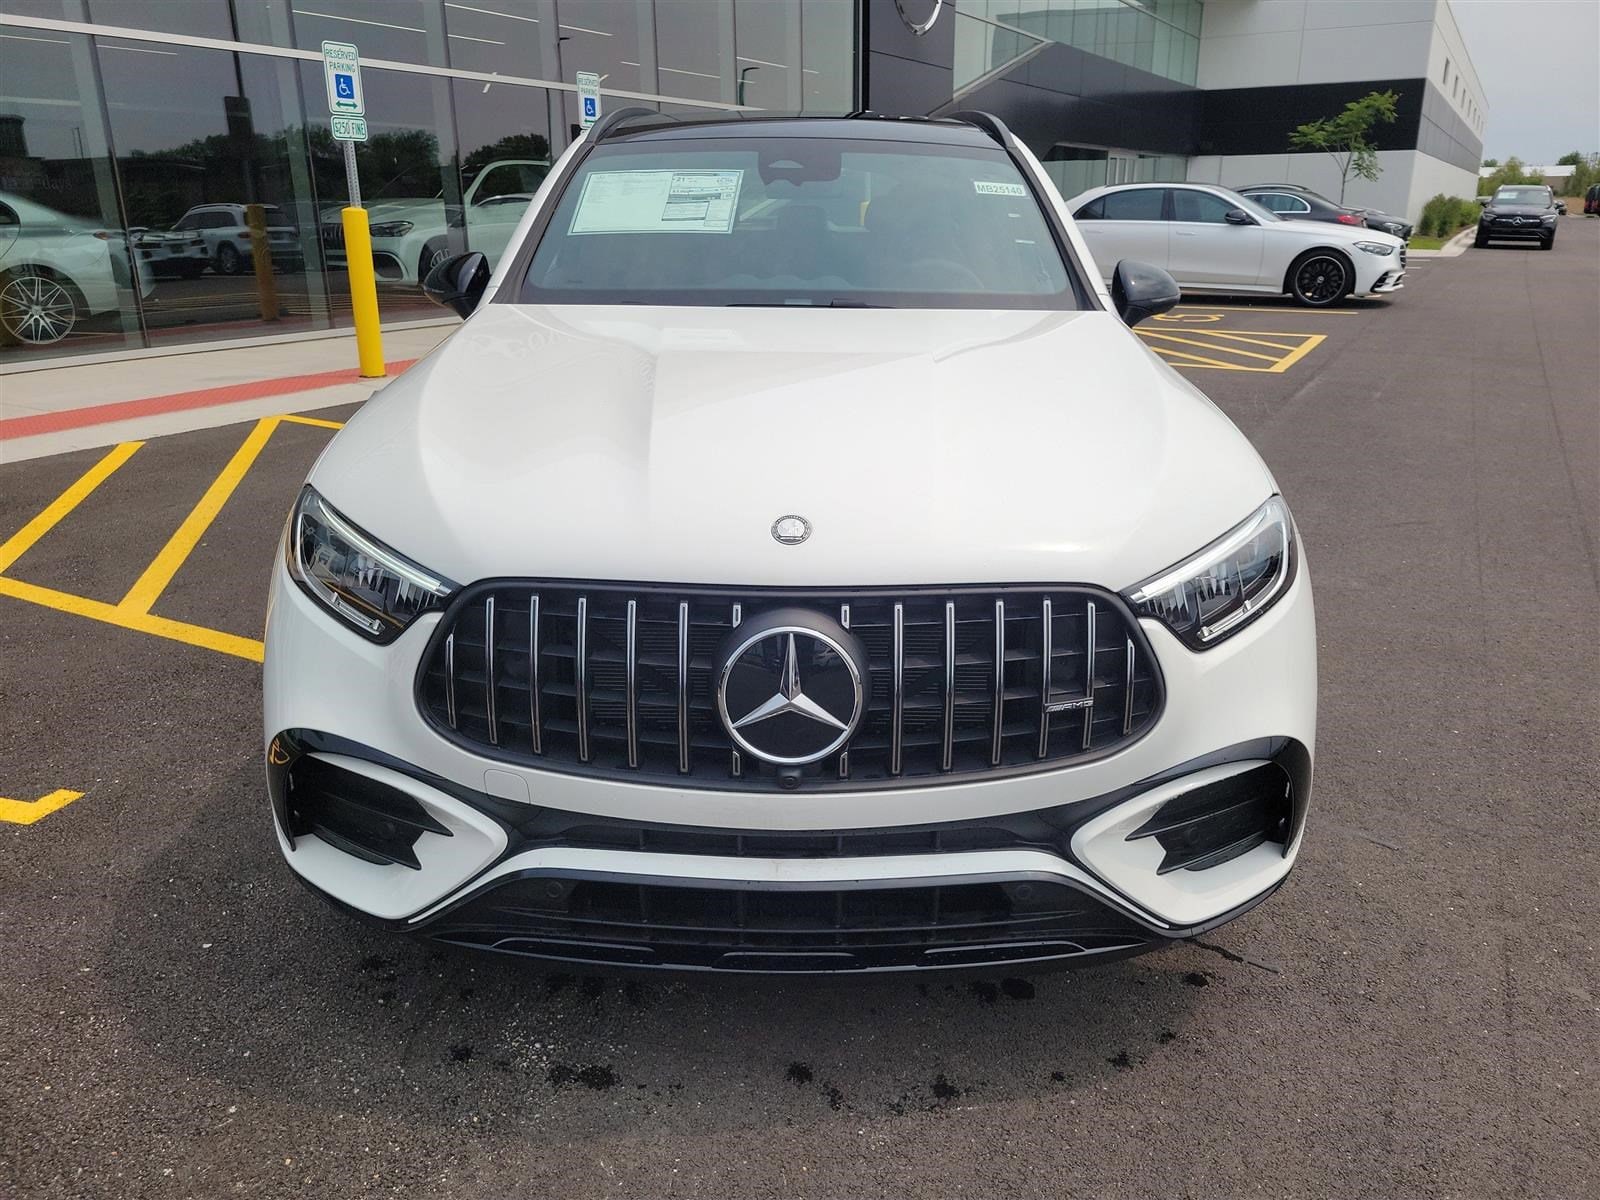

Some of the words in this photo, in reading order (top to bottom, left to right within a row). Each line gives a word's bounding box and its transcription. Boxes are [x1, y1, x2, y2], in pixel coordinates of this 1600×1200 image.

[325, 48, 356, 61] RESERVED
[329, 61, 356, 73] PARKING
[335, 120, 351, 134] $250
[351, 121, 365, 136] FINE
[977, 184, 1023, 195] MB25140
